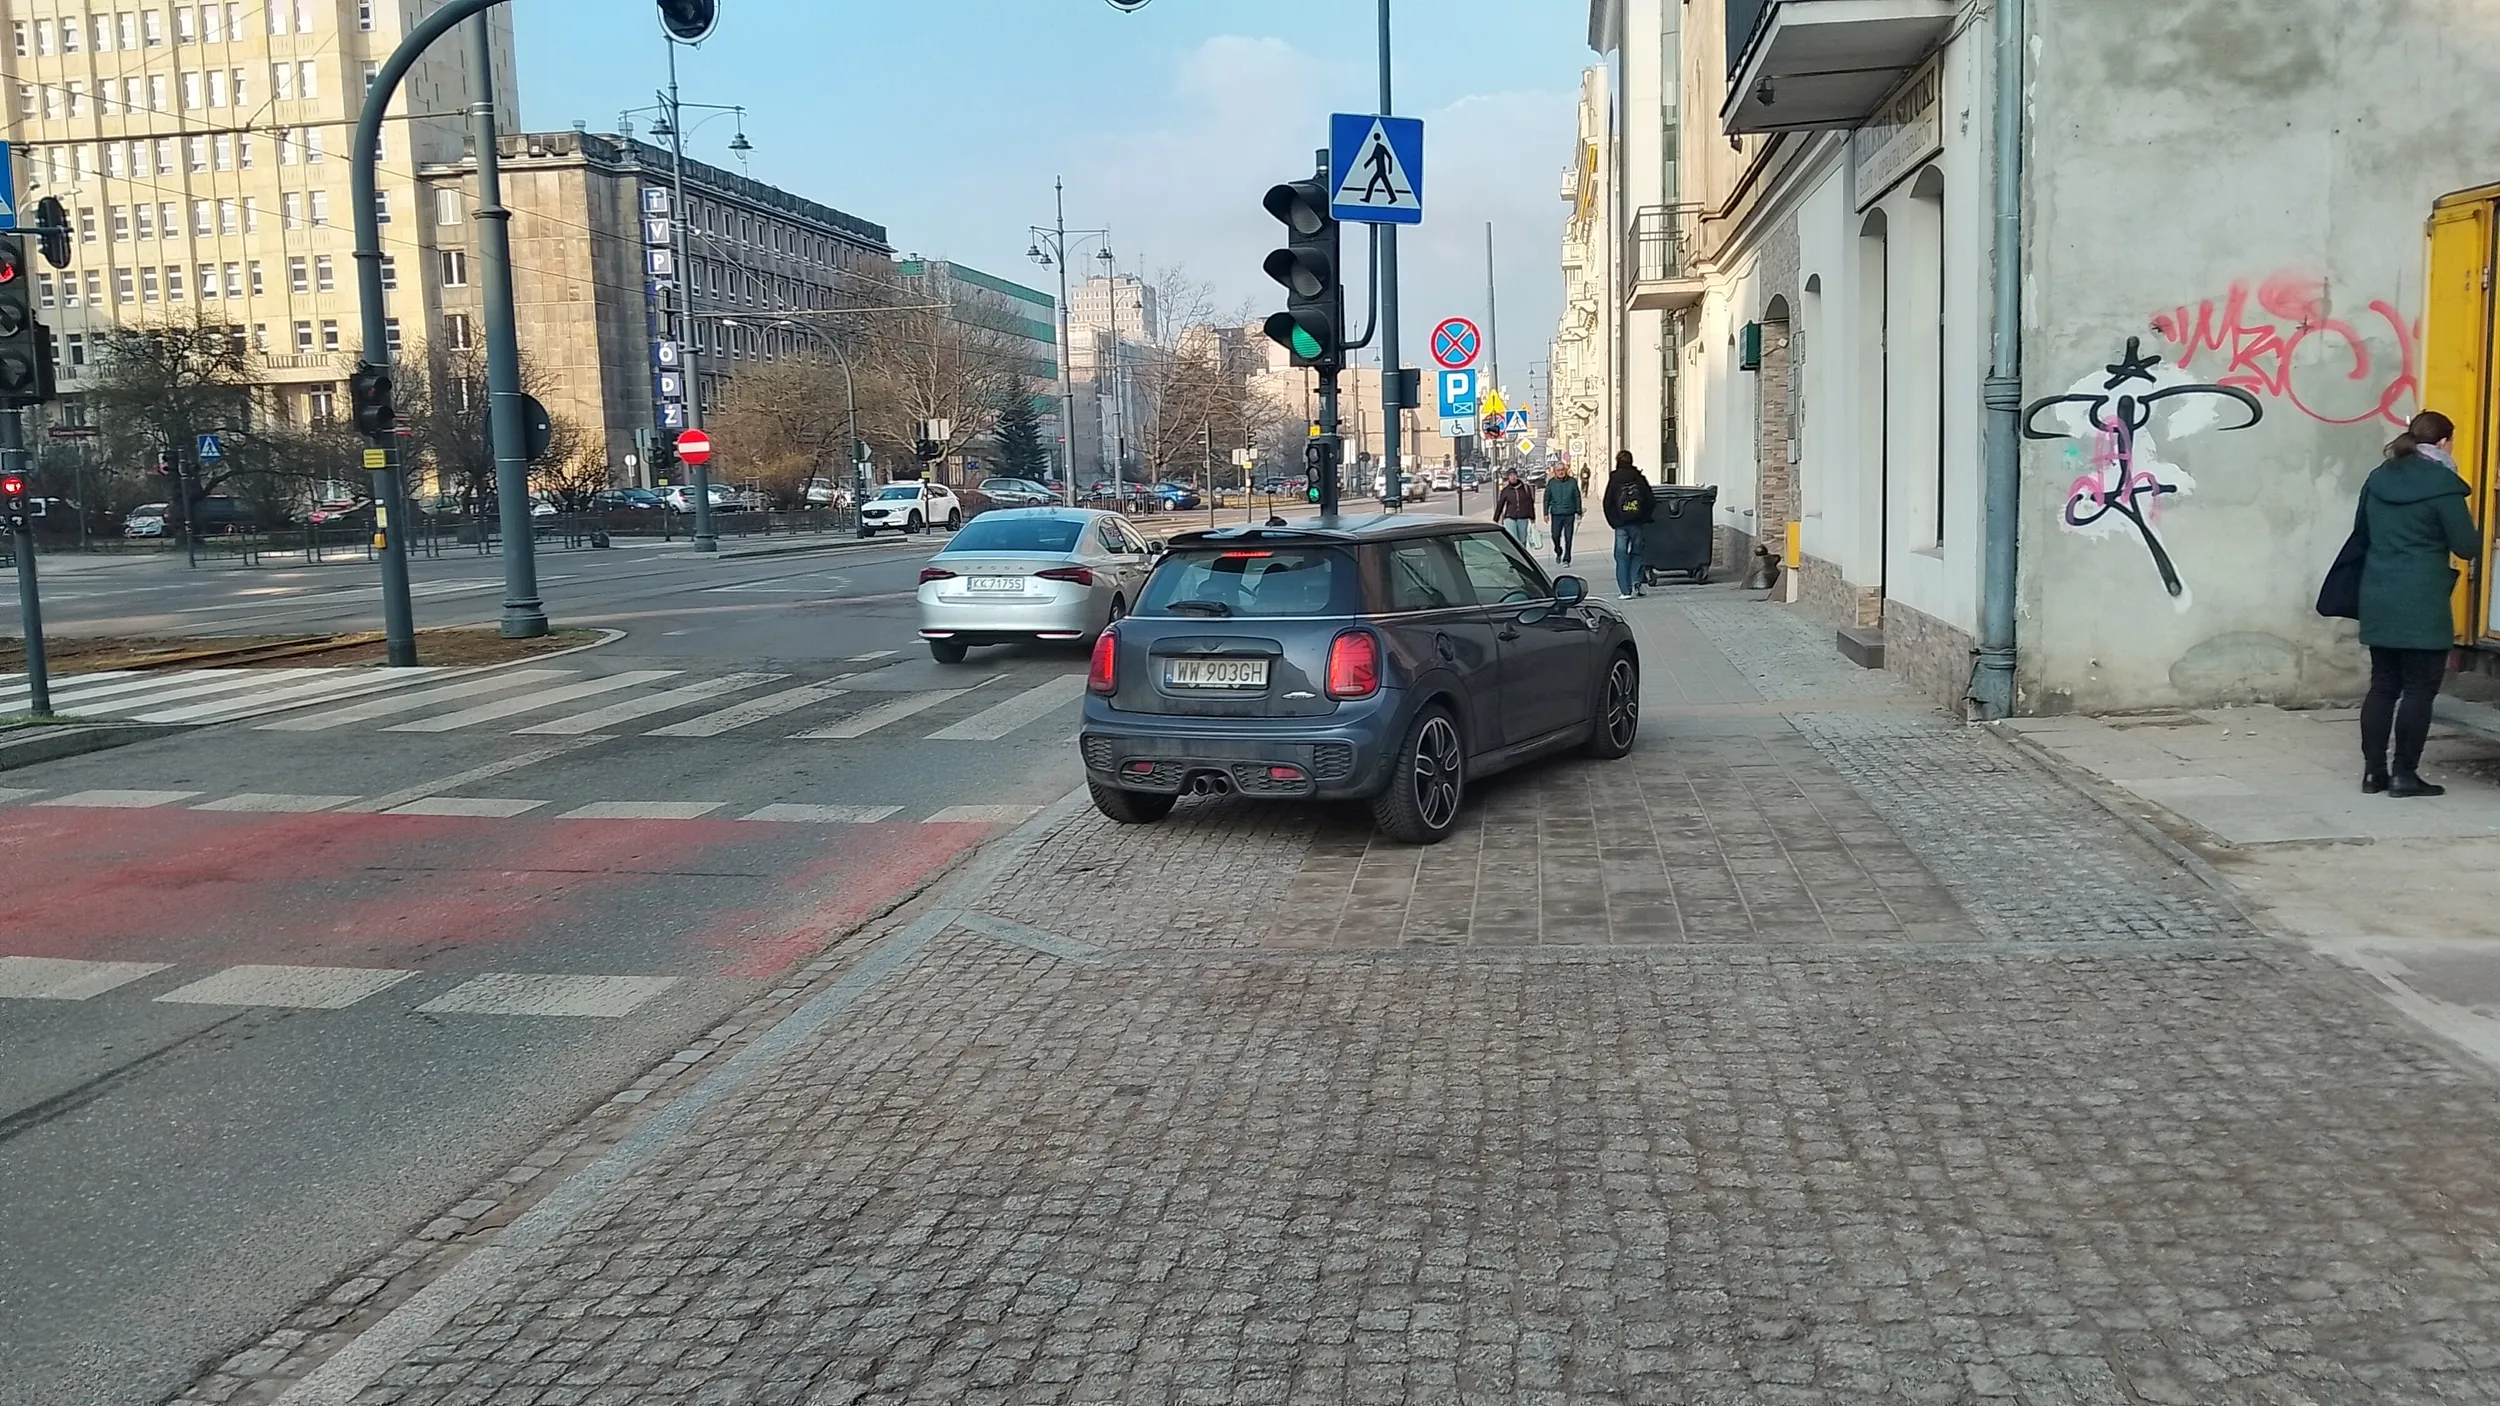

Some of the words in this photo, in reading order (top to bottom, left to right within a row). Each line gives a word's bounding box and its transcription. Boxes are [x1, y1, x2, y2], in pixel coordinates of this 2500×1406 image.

[1895, 66, 1935, 135] SZTUKI
[1446, 372, 1469, 404] P
[1177, 661, 1200, 682] WW
[1206, 662, 1263, 683] 903GH
